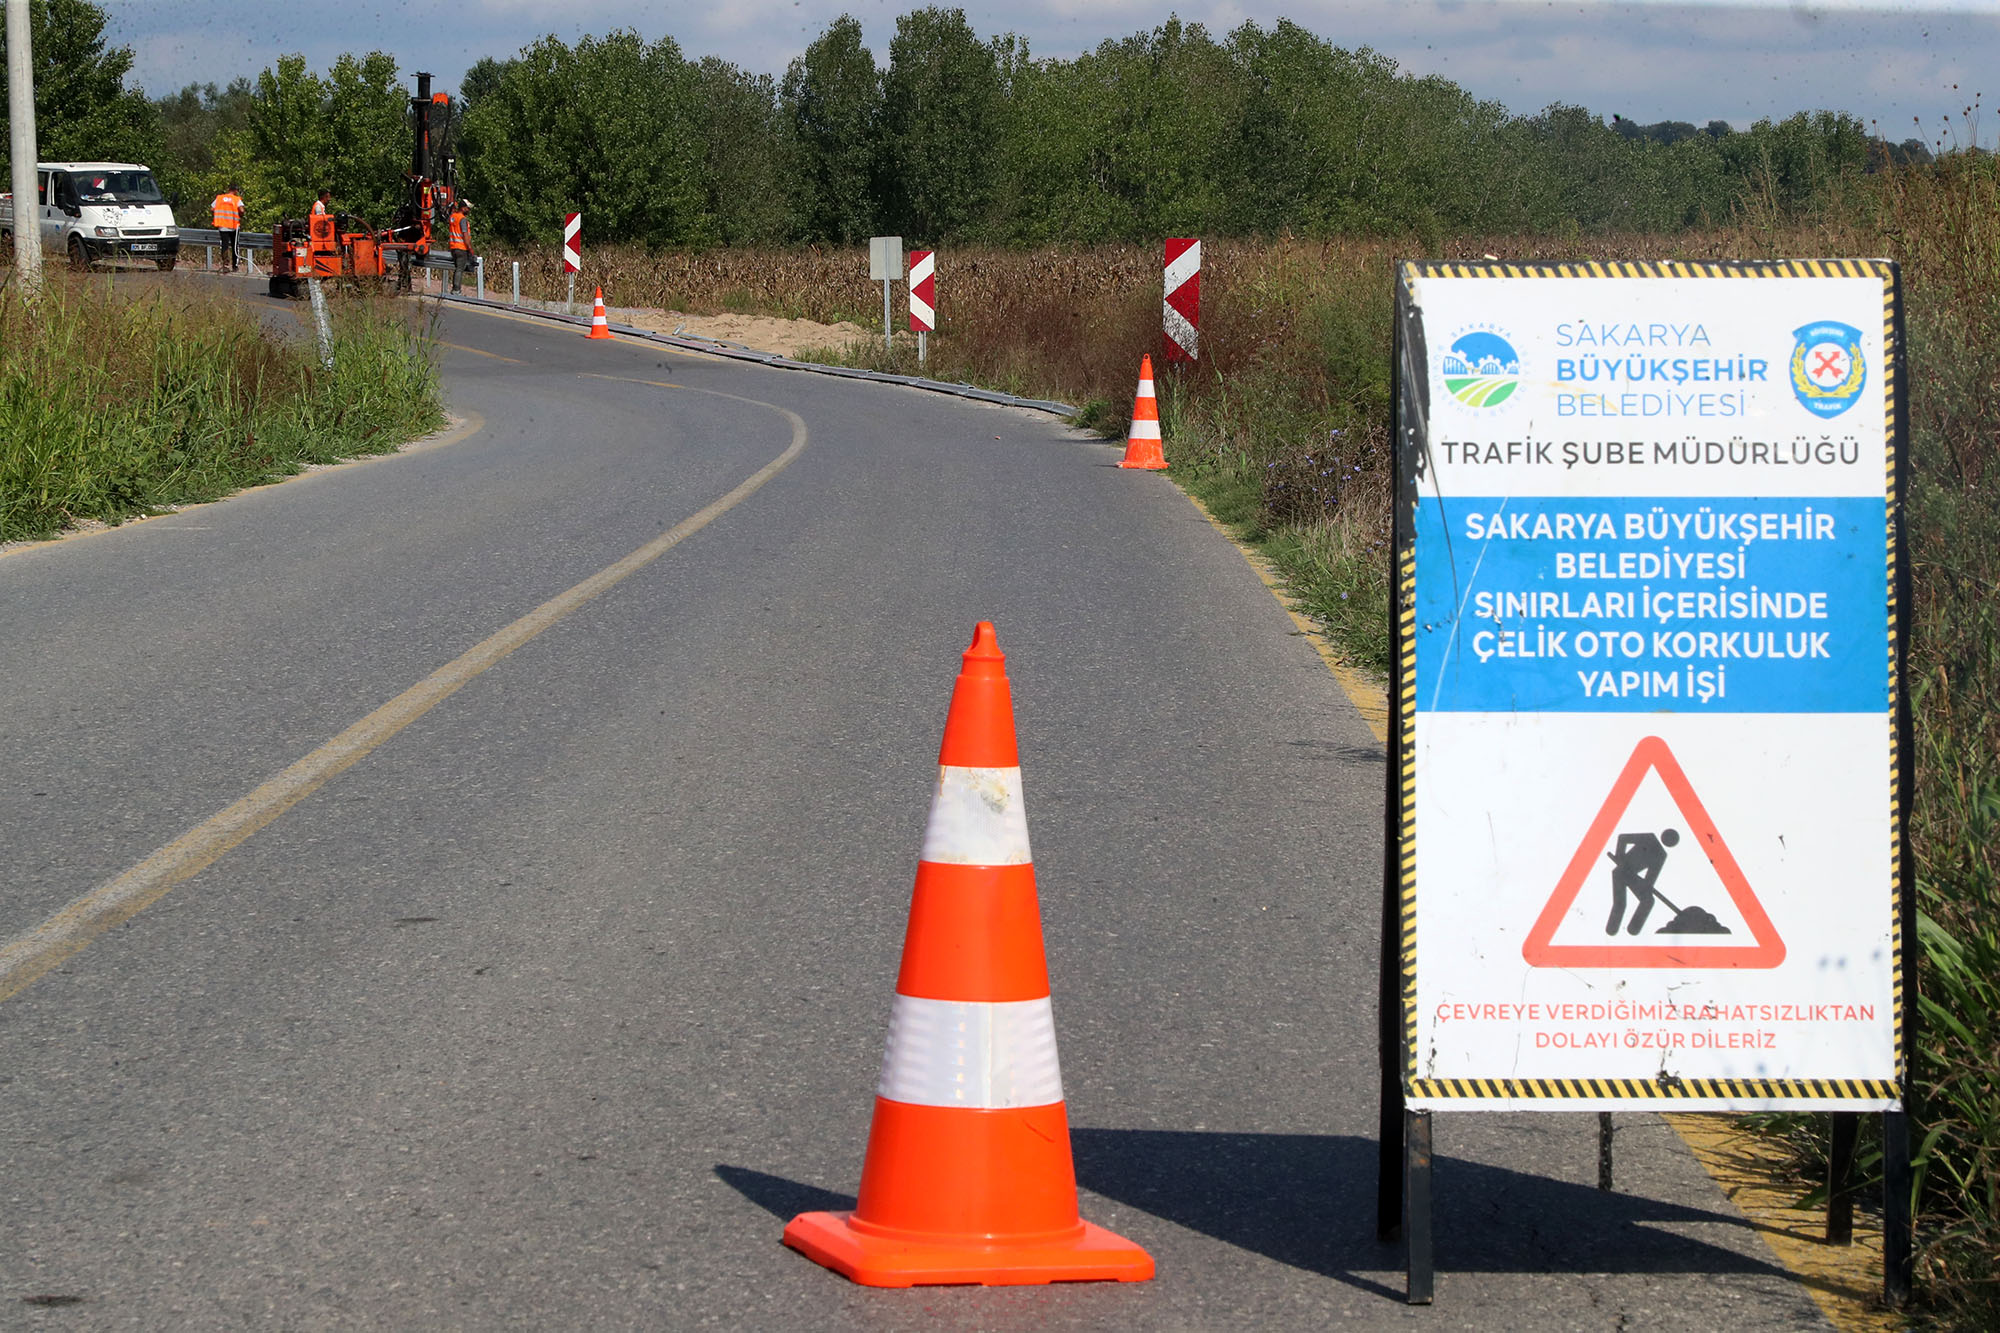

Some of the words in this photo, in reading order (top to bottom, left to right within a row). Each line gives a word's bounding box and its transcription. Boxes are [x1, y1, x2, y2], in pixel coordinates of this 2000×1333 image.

[1556, 324, 1711, 347] SAKARYA
[1556, 353, 1768, 386] BÜYÜKŞEHİR
[1556, 389, 1745, 416] BELEDİYESİ
[1441, 436, 1553, 464] TRAFİK
[1563, 442, 1644, 469] ŞUBE
[1654, 434, 1860, 465] MÜDÜRLÜĞÜ
[1466, 513, 1617, 539] SAKARYA
[1625, 507, 1835, 545] BÜYÜKŞEHİR
[1556, 546, 1746, 579] BELEDİYESİ
[1475, 591, 1634, 619] SINIRLARI
[1644, 586, 1827, 624] İÇERİSİNDE
[1473, 625, 1567, 662] ÇELİK
[1575, 631, 1644, 658] OTO
[1654, 632, 1830, 658] KORKULUK
[1578, 671, 1678, 697] YAPIM
[1688, 665, 1724, 703] İŞİ
[1438, 1004, 1539, 1023] ÇEVREYE
[1546, 1000, 1677, 1020] VERDİĞİMİZ
[1684, 1005, 1874, 1021] RAHATSIZLIKTAN
[1536, 1032, 1617, 1048] DOLAYI
[1624, 1029, 1685, 1048] ÖZÜR
[1692, 1030, 1776, 1048] DİLERİZ
